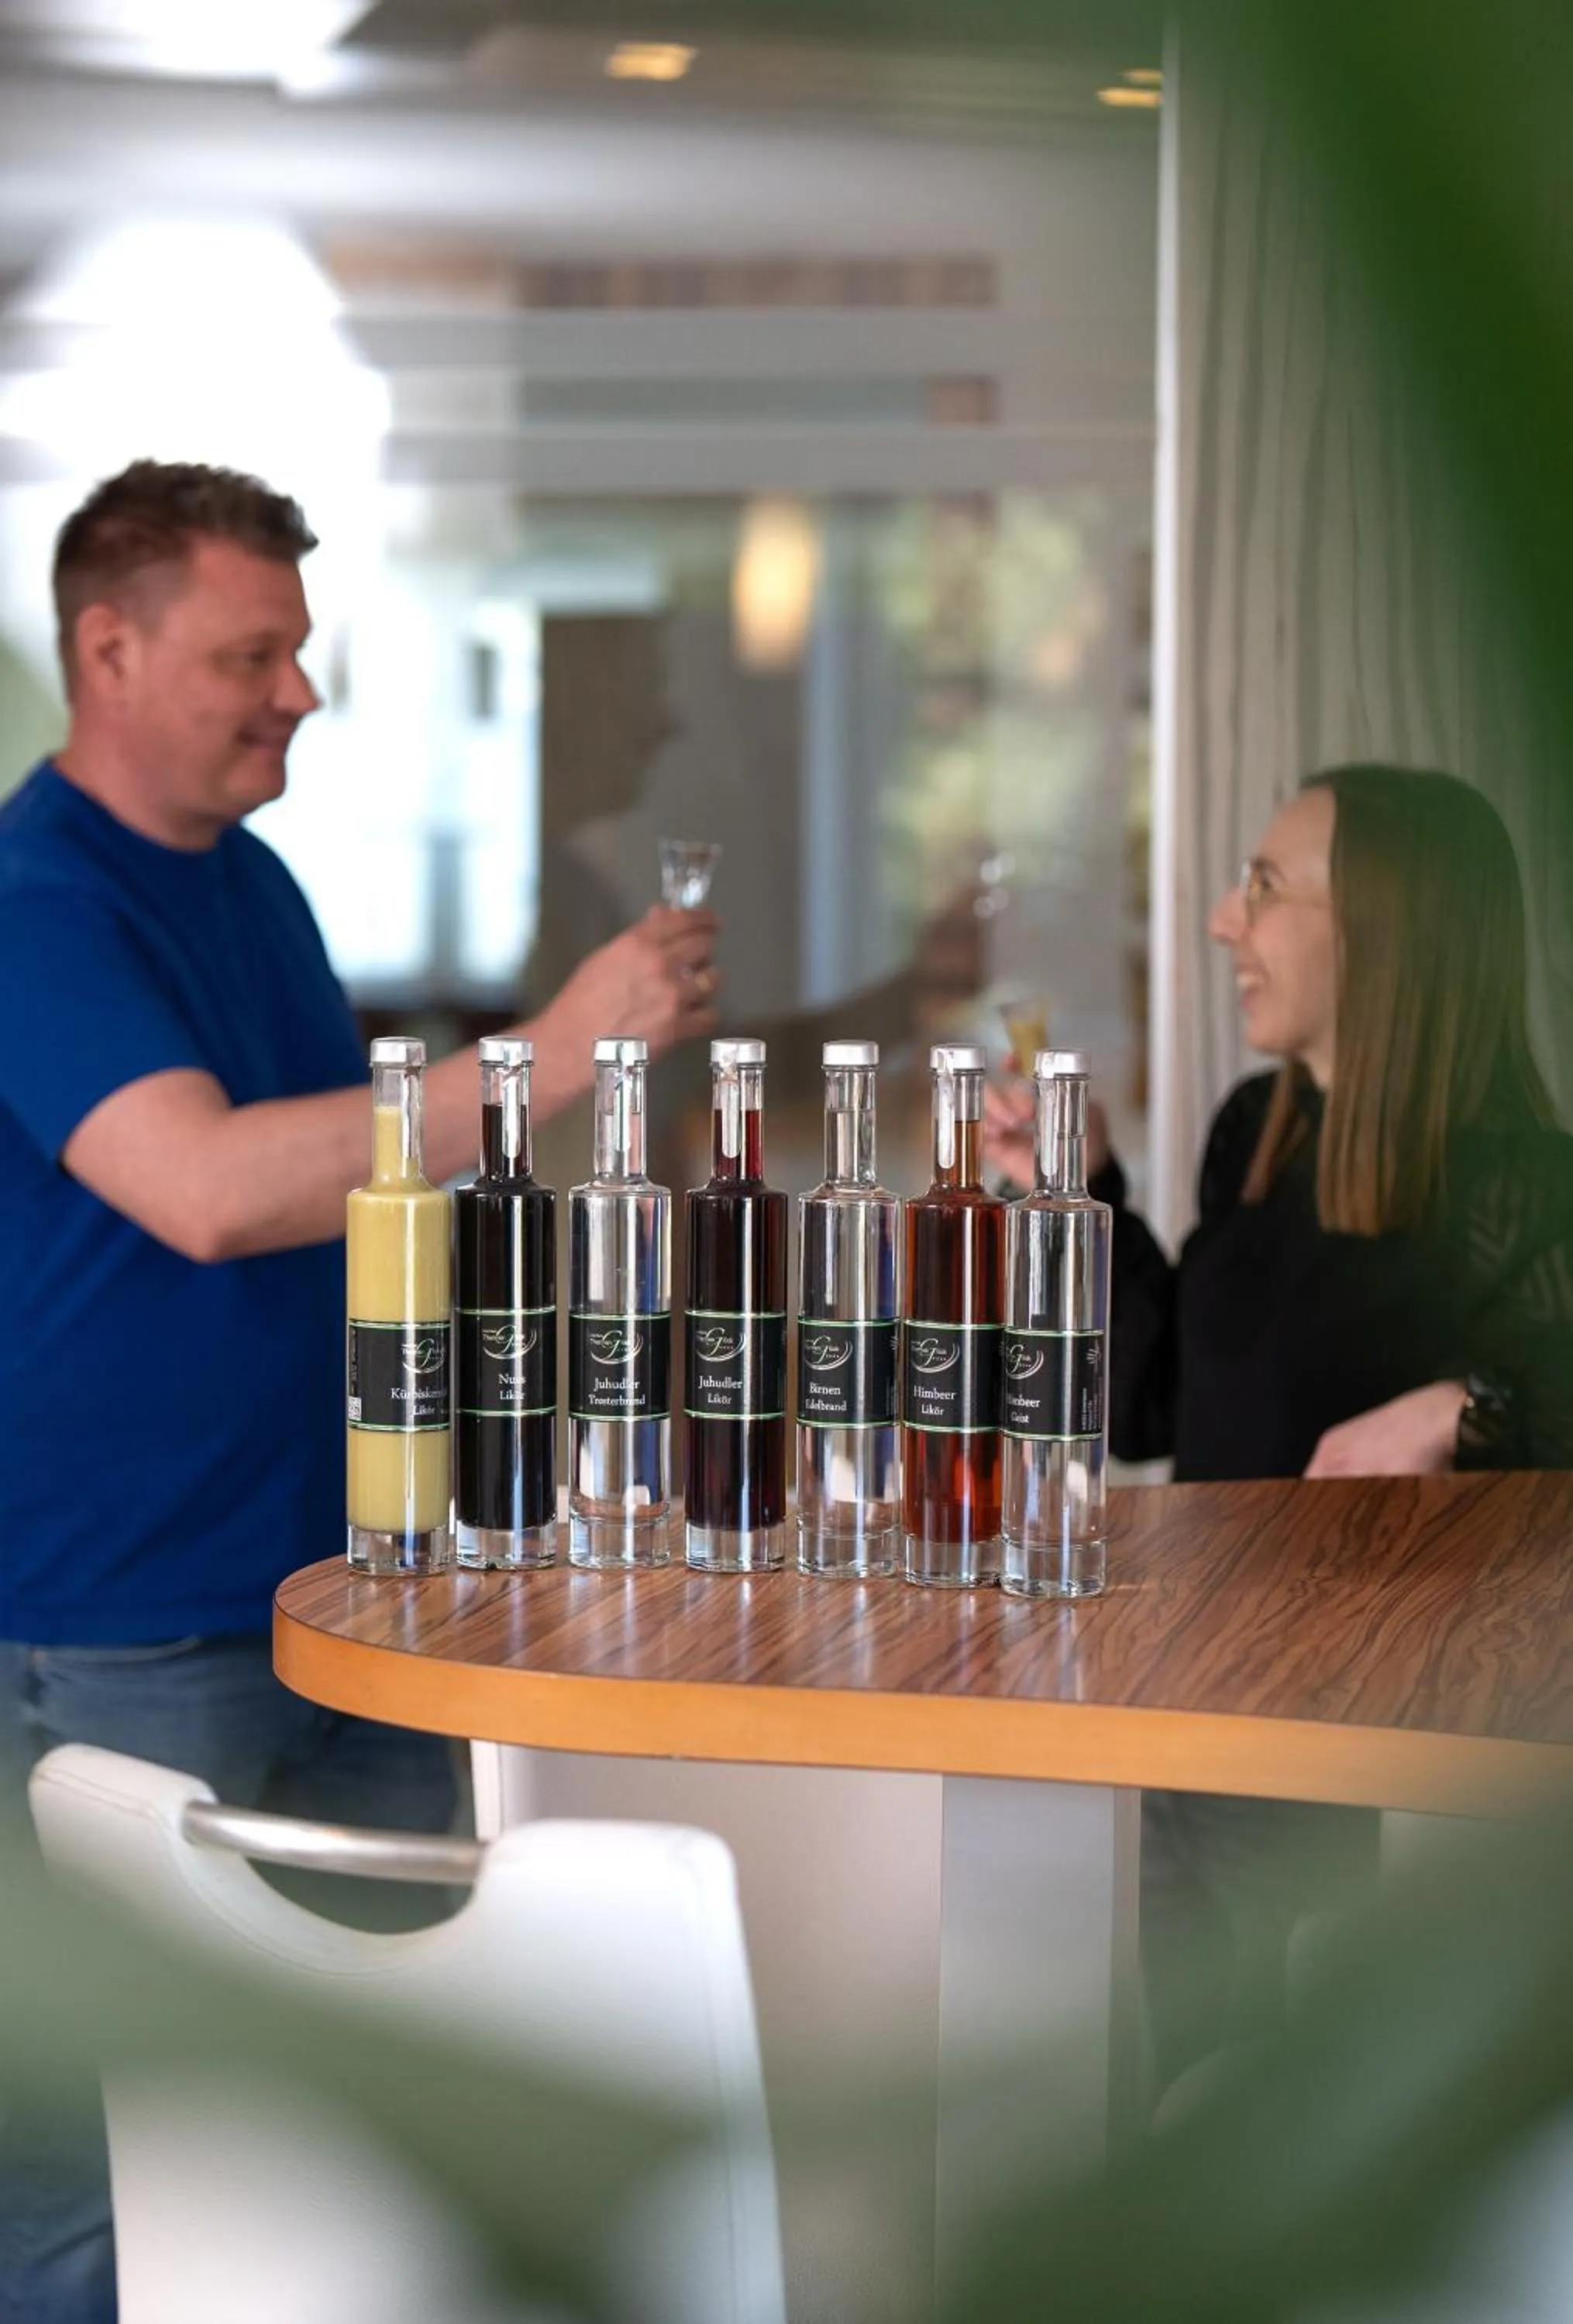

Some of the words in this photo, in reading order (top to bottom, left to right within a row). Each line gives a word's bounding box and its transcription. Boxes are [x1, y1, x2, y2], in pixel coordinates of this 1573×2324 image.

[498, 1373, 526, 1384] Nus
[594, 1377, 640, 1392] Juhudlr
[698, 1376, 743, 1389] Juhudler
[500, 1390, 525, 1400] Likr
[810, 1382, 841, 1395] Birnen
[914, 1385, 955, 1400] Himbeer
[707, 1393, 732, 1404] Likör
[1008, 1394, 1041, 1408] mbeer
[921, 1404, 945, 1416] Likör
